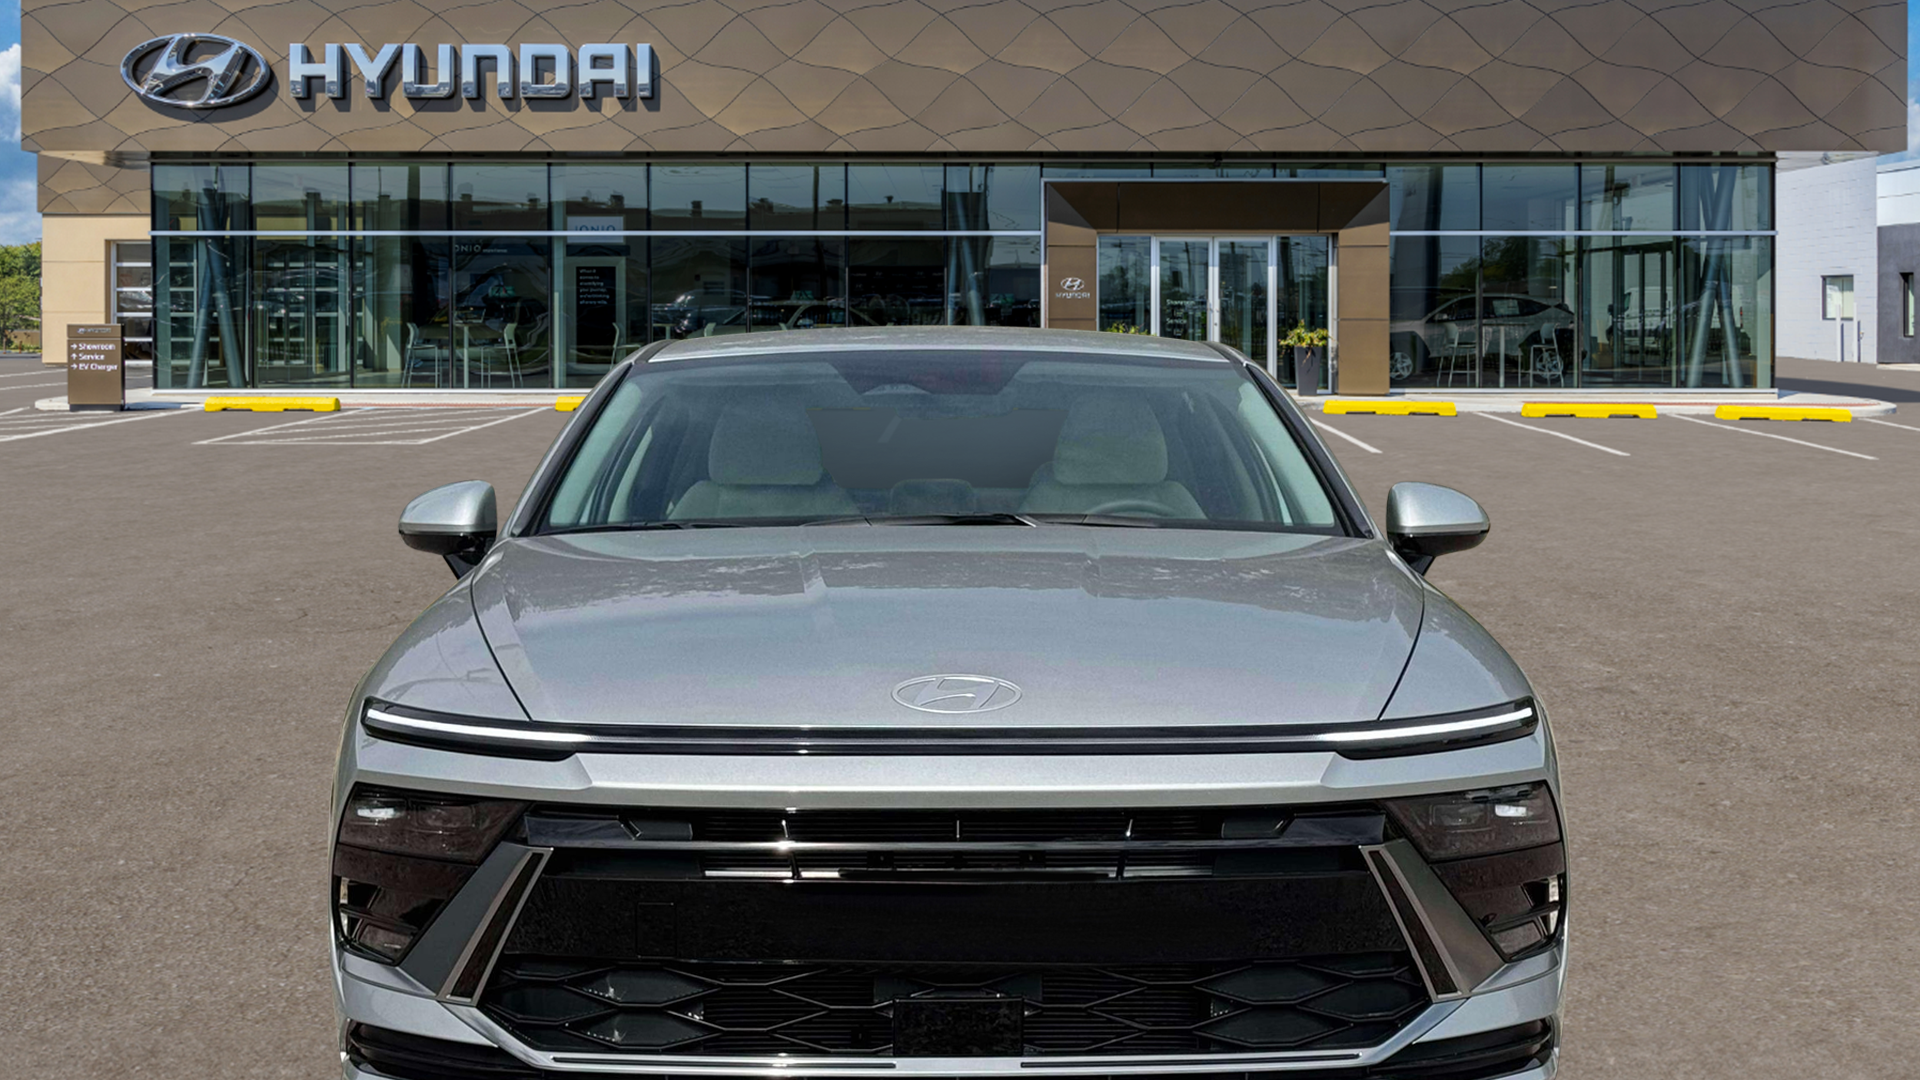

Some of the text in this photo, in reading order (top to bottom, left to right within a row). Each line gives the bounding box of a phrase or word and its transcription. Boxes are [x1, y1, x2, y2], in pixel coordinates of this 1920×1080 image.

[289, 43, 654, 98] HYUNDAI
[78, 343, 116, 351] Showroom
[78, 352, 105, 360] Service
[90, 363, 118, 372] Charger
